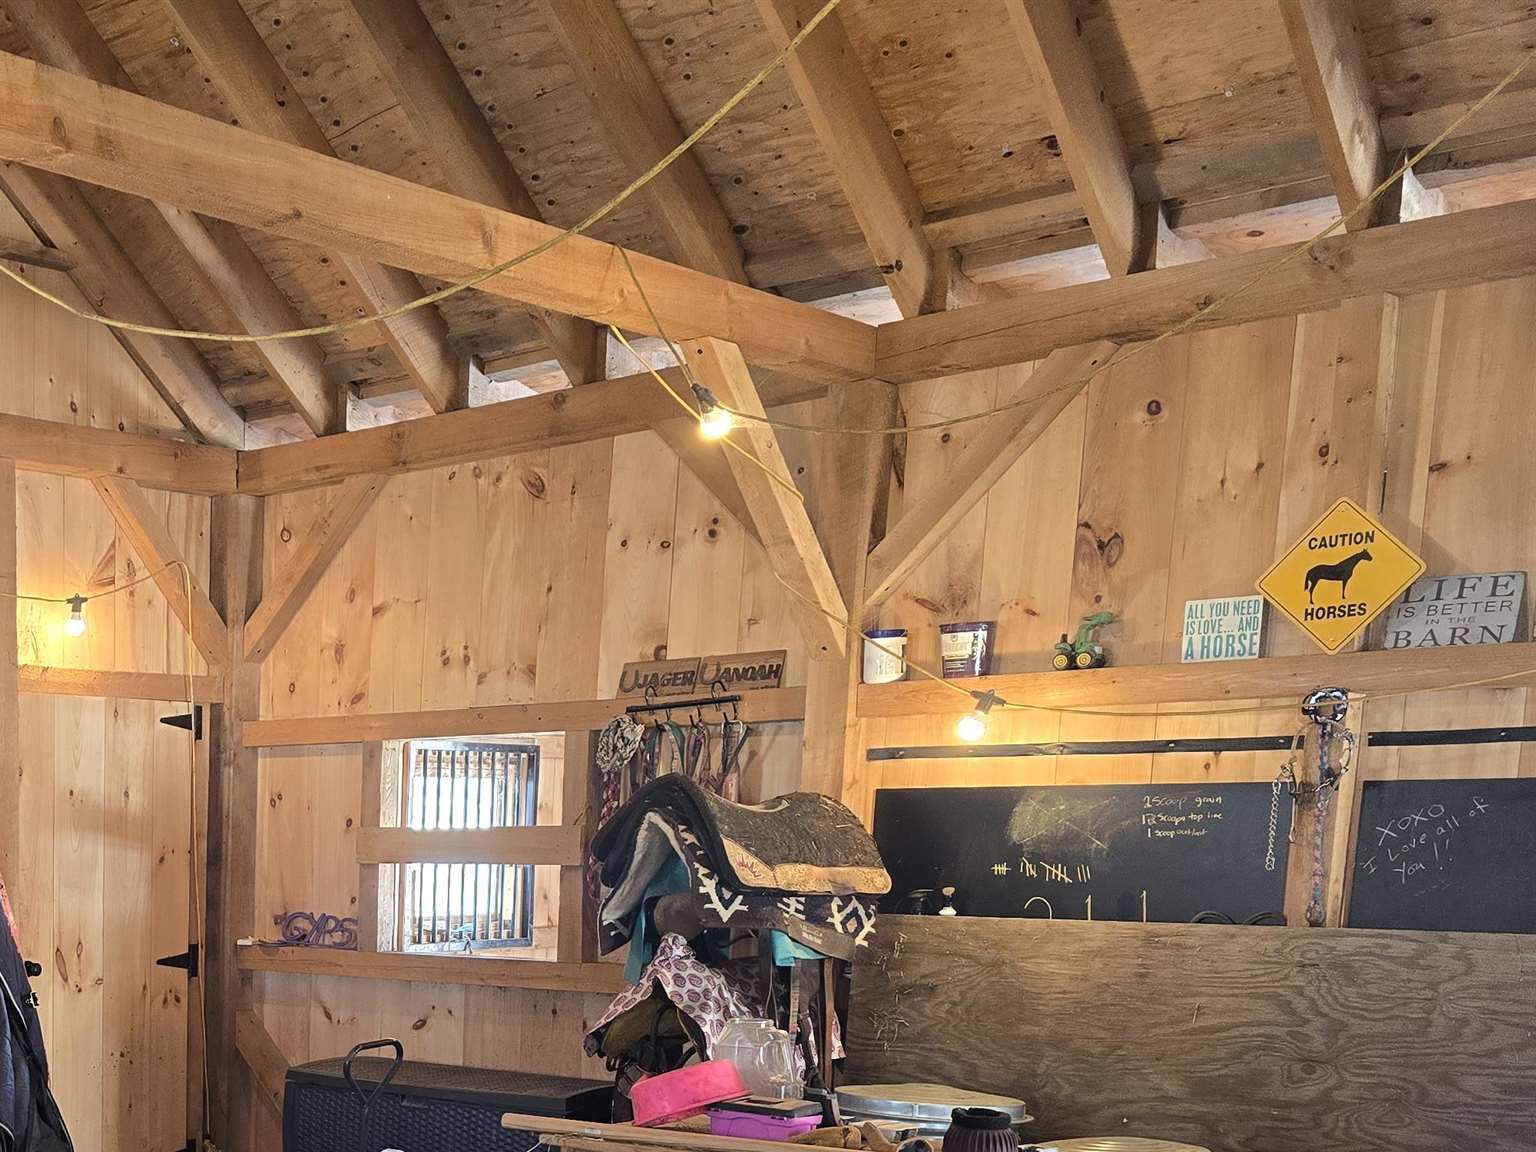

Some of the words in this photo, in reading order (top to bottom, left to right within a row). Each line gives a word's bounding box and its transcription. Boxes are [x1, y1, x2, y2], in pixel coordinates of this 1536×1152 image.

[1308, 530, 1375, 550] CAUTION
[1399, 574, 1516, 605] LIFE
[1187, 604, 1205, 619] ALL
[1209, 602, 1230, 617] YOU
[1232, 599, 1260, 616] NEED
[1304, 602, 1367, 621] HORSES
[1396, 606, 1415, 619] IS
[1426, 600, 1513, 617] BETTER
[1186, 620, 1195, 635] IS
[1238, 616, 1259, 632] AND
[1447, 616, 1477, 624] THE
[1184, 637, 1194, 660] A
[1200, 632, 1258, 659] HORSE
[1390, 624, 1508, 649] BARN
[1375, 804, 1445, 846] XOXO
